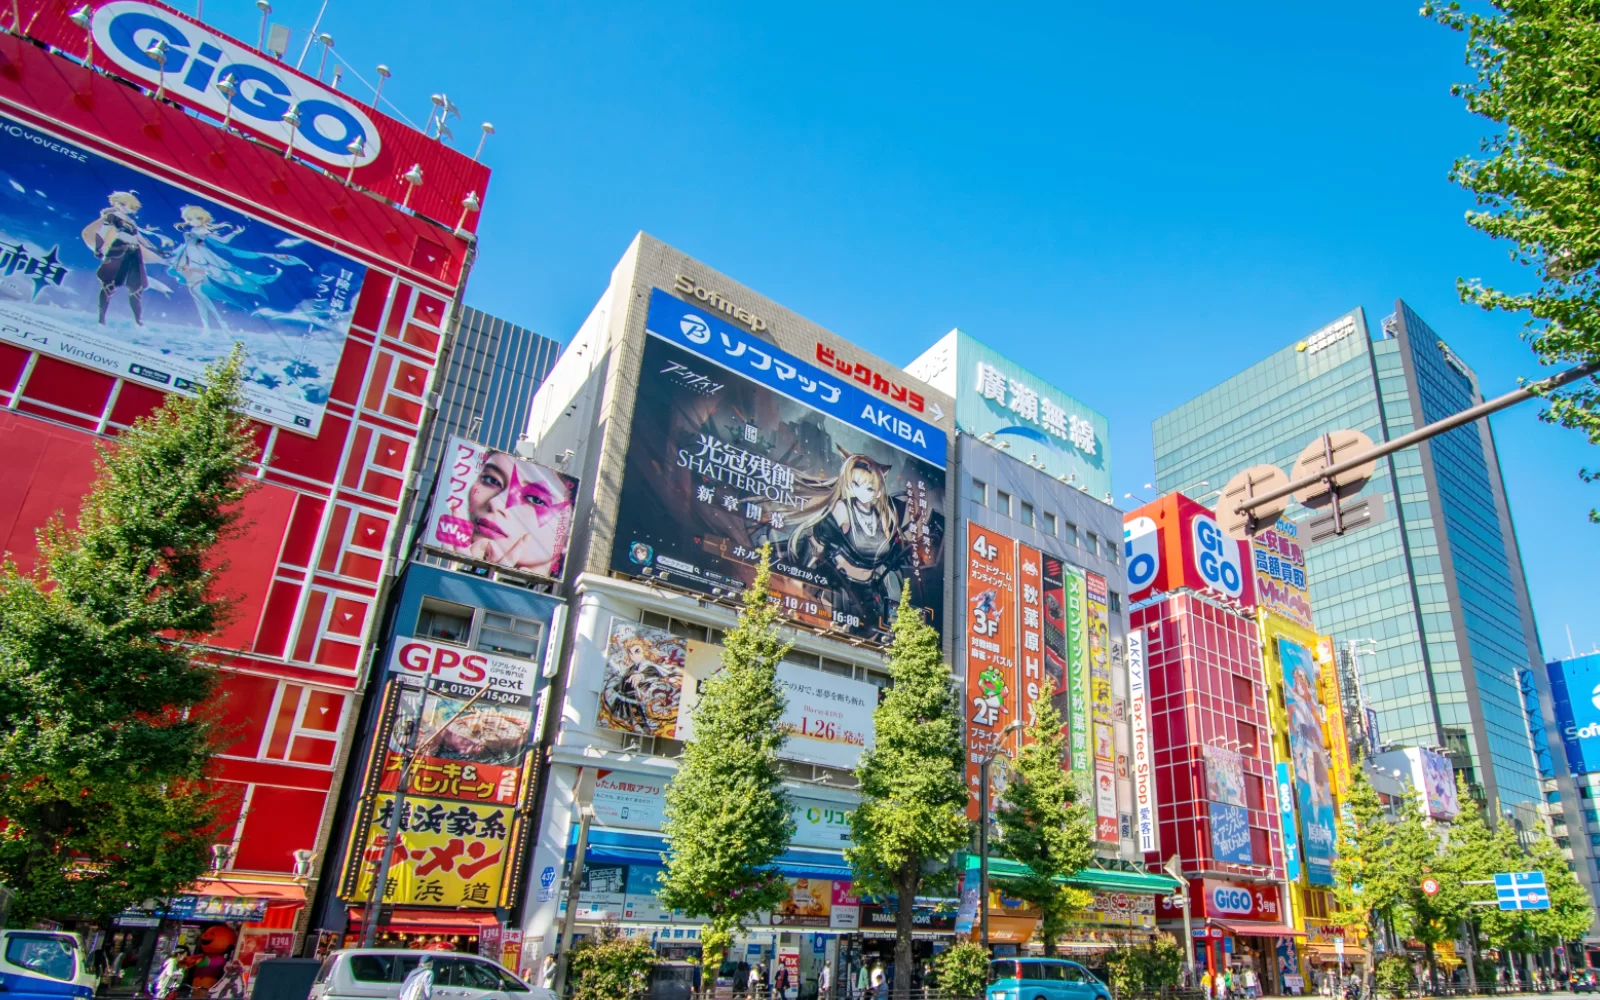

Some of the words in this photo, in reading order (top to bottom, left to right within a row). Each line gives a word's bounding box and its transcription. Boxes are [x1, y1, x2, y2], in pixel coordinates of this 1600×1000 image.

[108, 12, 367, 157] GiGO
[674, 273, 767, 333] Sofmap
[59, 341, 120, 369] Windows
[720, 331, 842, 404] ソフマップ
[861, 404, 927, 449] AKIBA
[816, 342, 925, 413] ビックカメラ
[975, 361, 1097, 456] 廣瀬無線
[445, 443, 476, 513] ワクワク
[677, 449, 809, 512] SHATTERPOINT
[973, 535, 998, 562] 4F
[971, 560, 1013, 581] カードゲーム
[971, 570, 1013, 592] オンラインゲーム
[1199, 550, 1241, 592] GO
[1255, 549, 1307, 590] 高額買取
[973, 609, 998, 638] 3F
[398, 643, 488, 683] GPS
[488, 676, 524, 691] next
[973, 697, 999, 727] 2F
[1129, 637, 1143, 680] AKKY
[1136, 763, 1149, 805] Shop
[843, 729, 865, 747] 発売
[496, 769, 518, 802] 2F
[541, 872, 555, 881] 437
[1425, 882, 1437, 891] 50
[1215, 889, 1251, 911] GiGO
